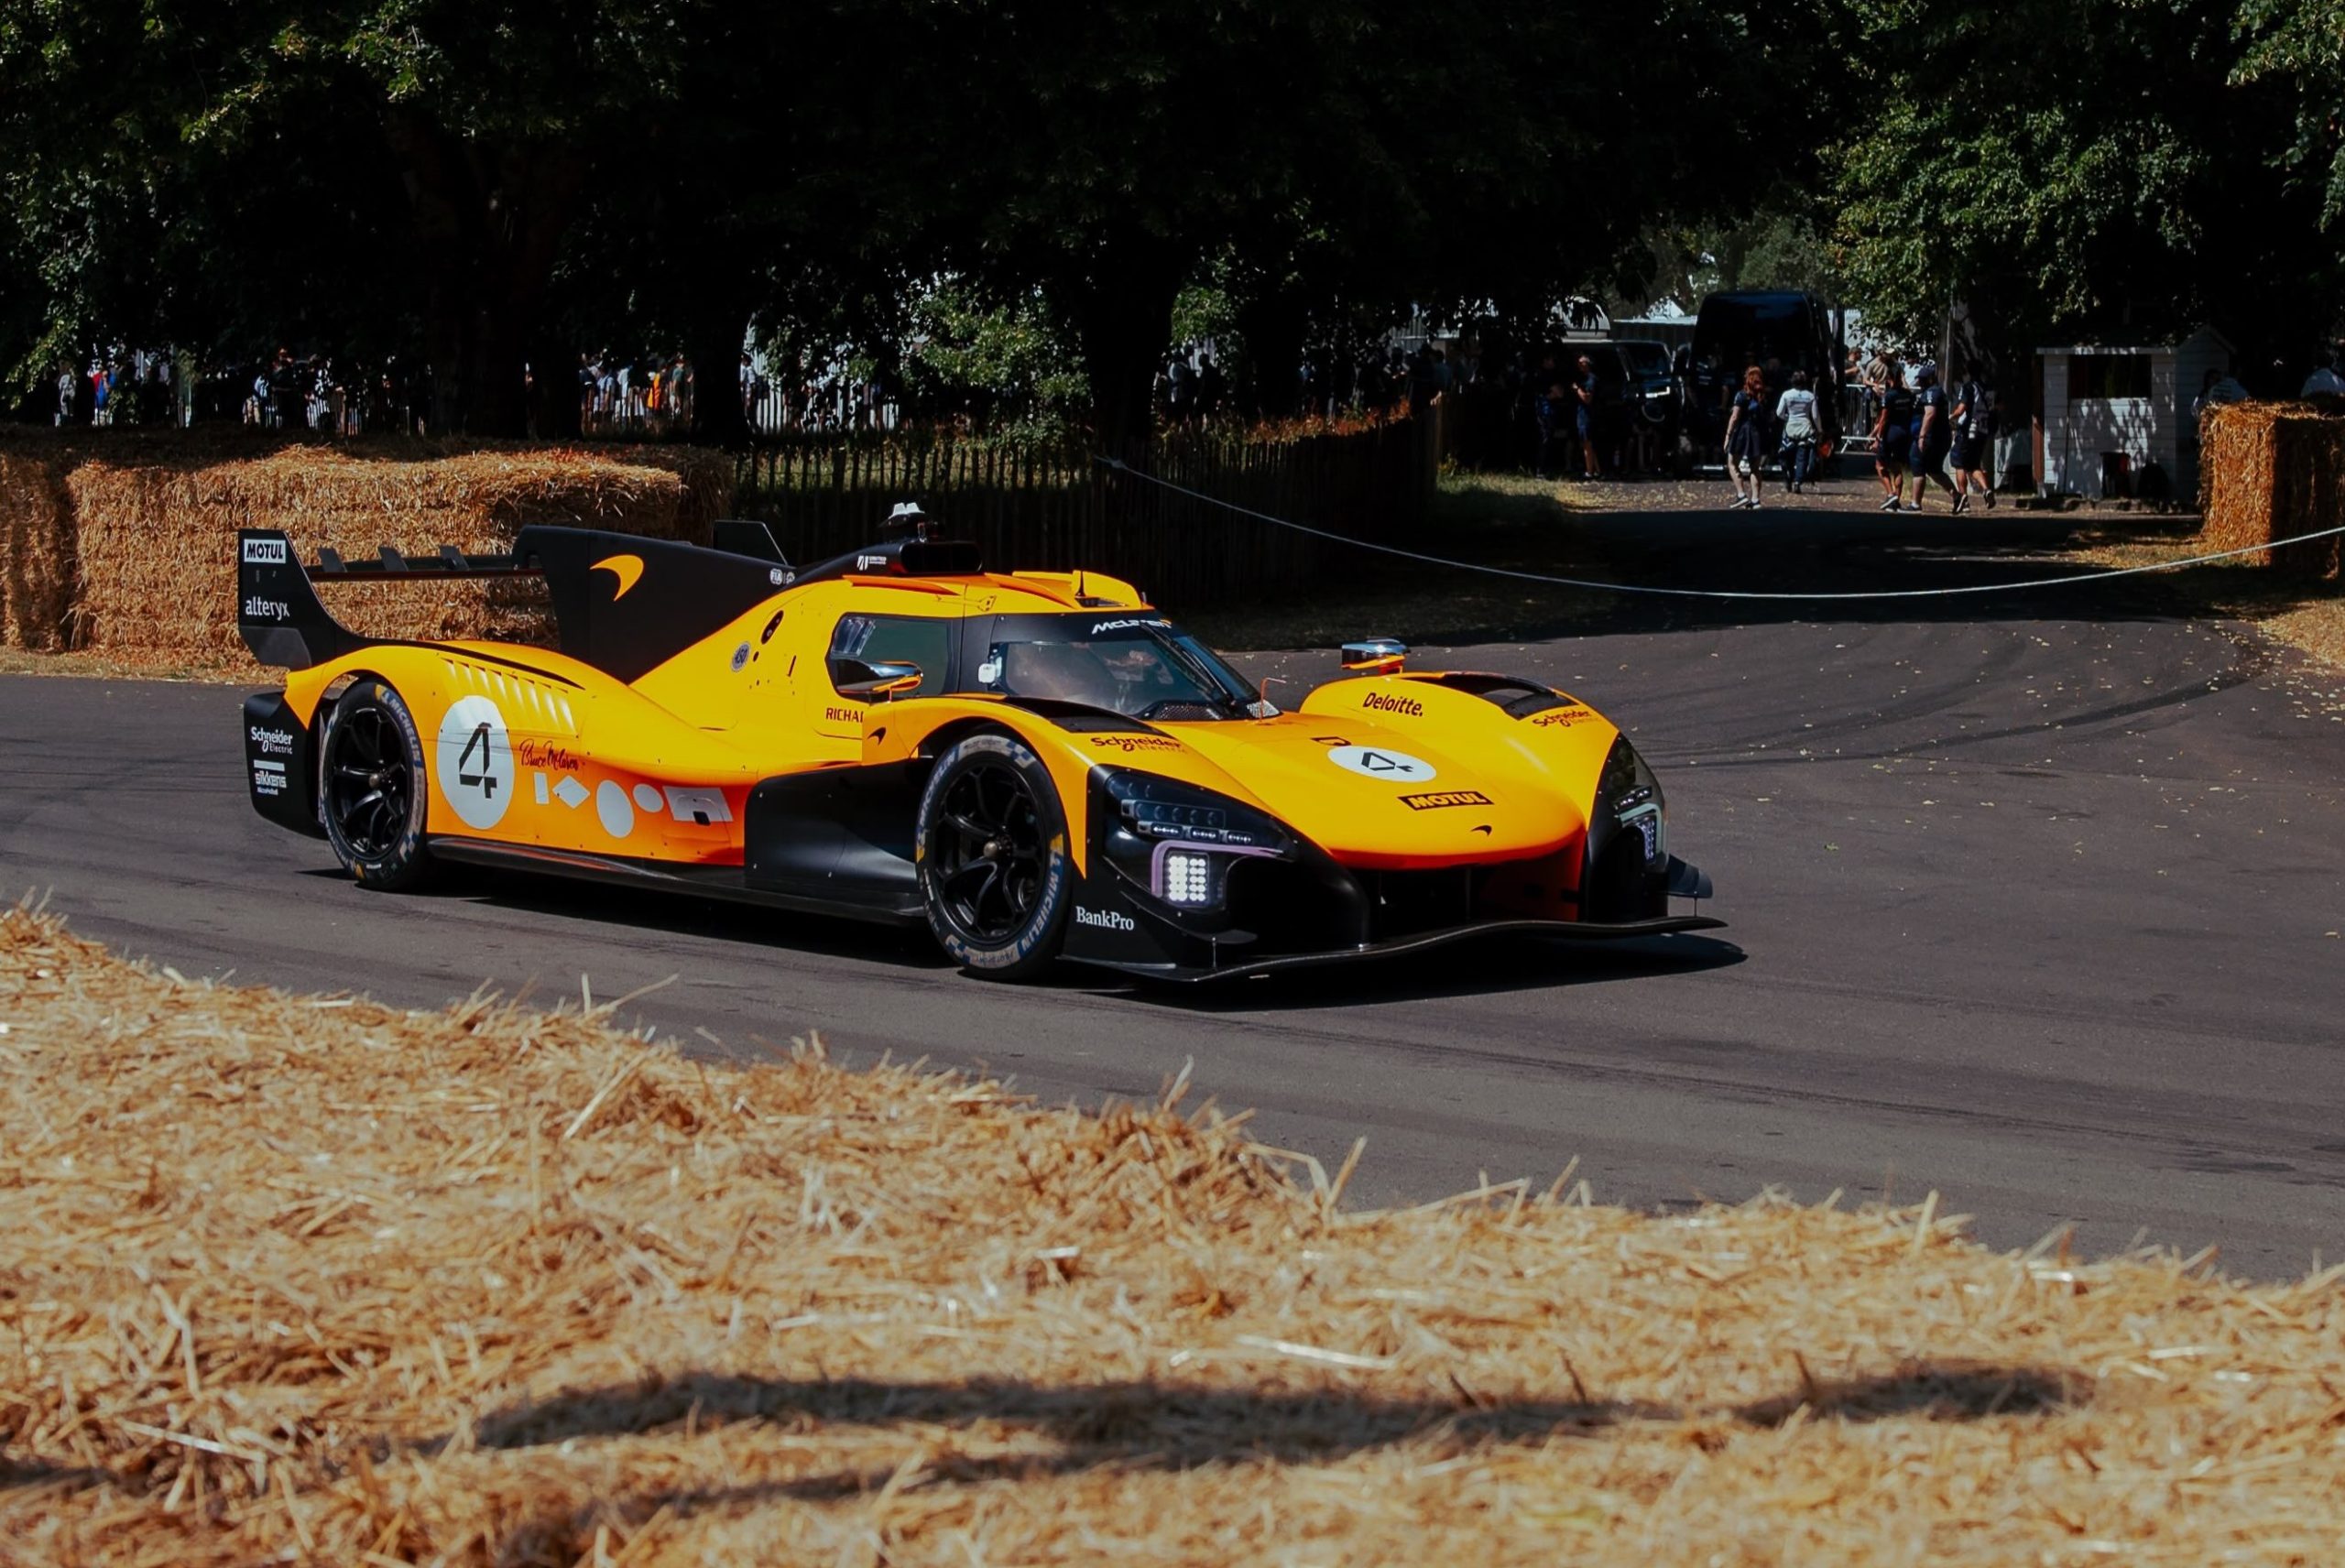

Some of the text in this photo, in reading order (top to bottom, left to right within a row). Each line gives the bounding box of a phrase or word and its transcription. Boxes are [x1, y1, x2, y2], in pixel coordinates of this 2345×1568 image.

[246, 542, 285, 560] MOTUL
[245, 596, 290, 621] alteryx
[1362, 691, 1423, 717] Deloitte.
[250, 726, 293, 746] Schneider
[1090, 736, 1181, 748] Schneider
[459, 722, 497, 800] 4
[1361, 751, 1415, 772] 4
[1407, 793, 1488, 809] MOTUL
[1020, 870, 1060, 952] MICHELIN
[1075, 906, 1135, 931] BankPro
